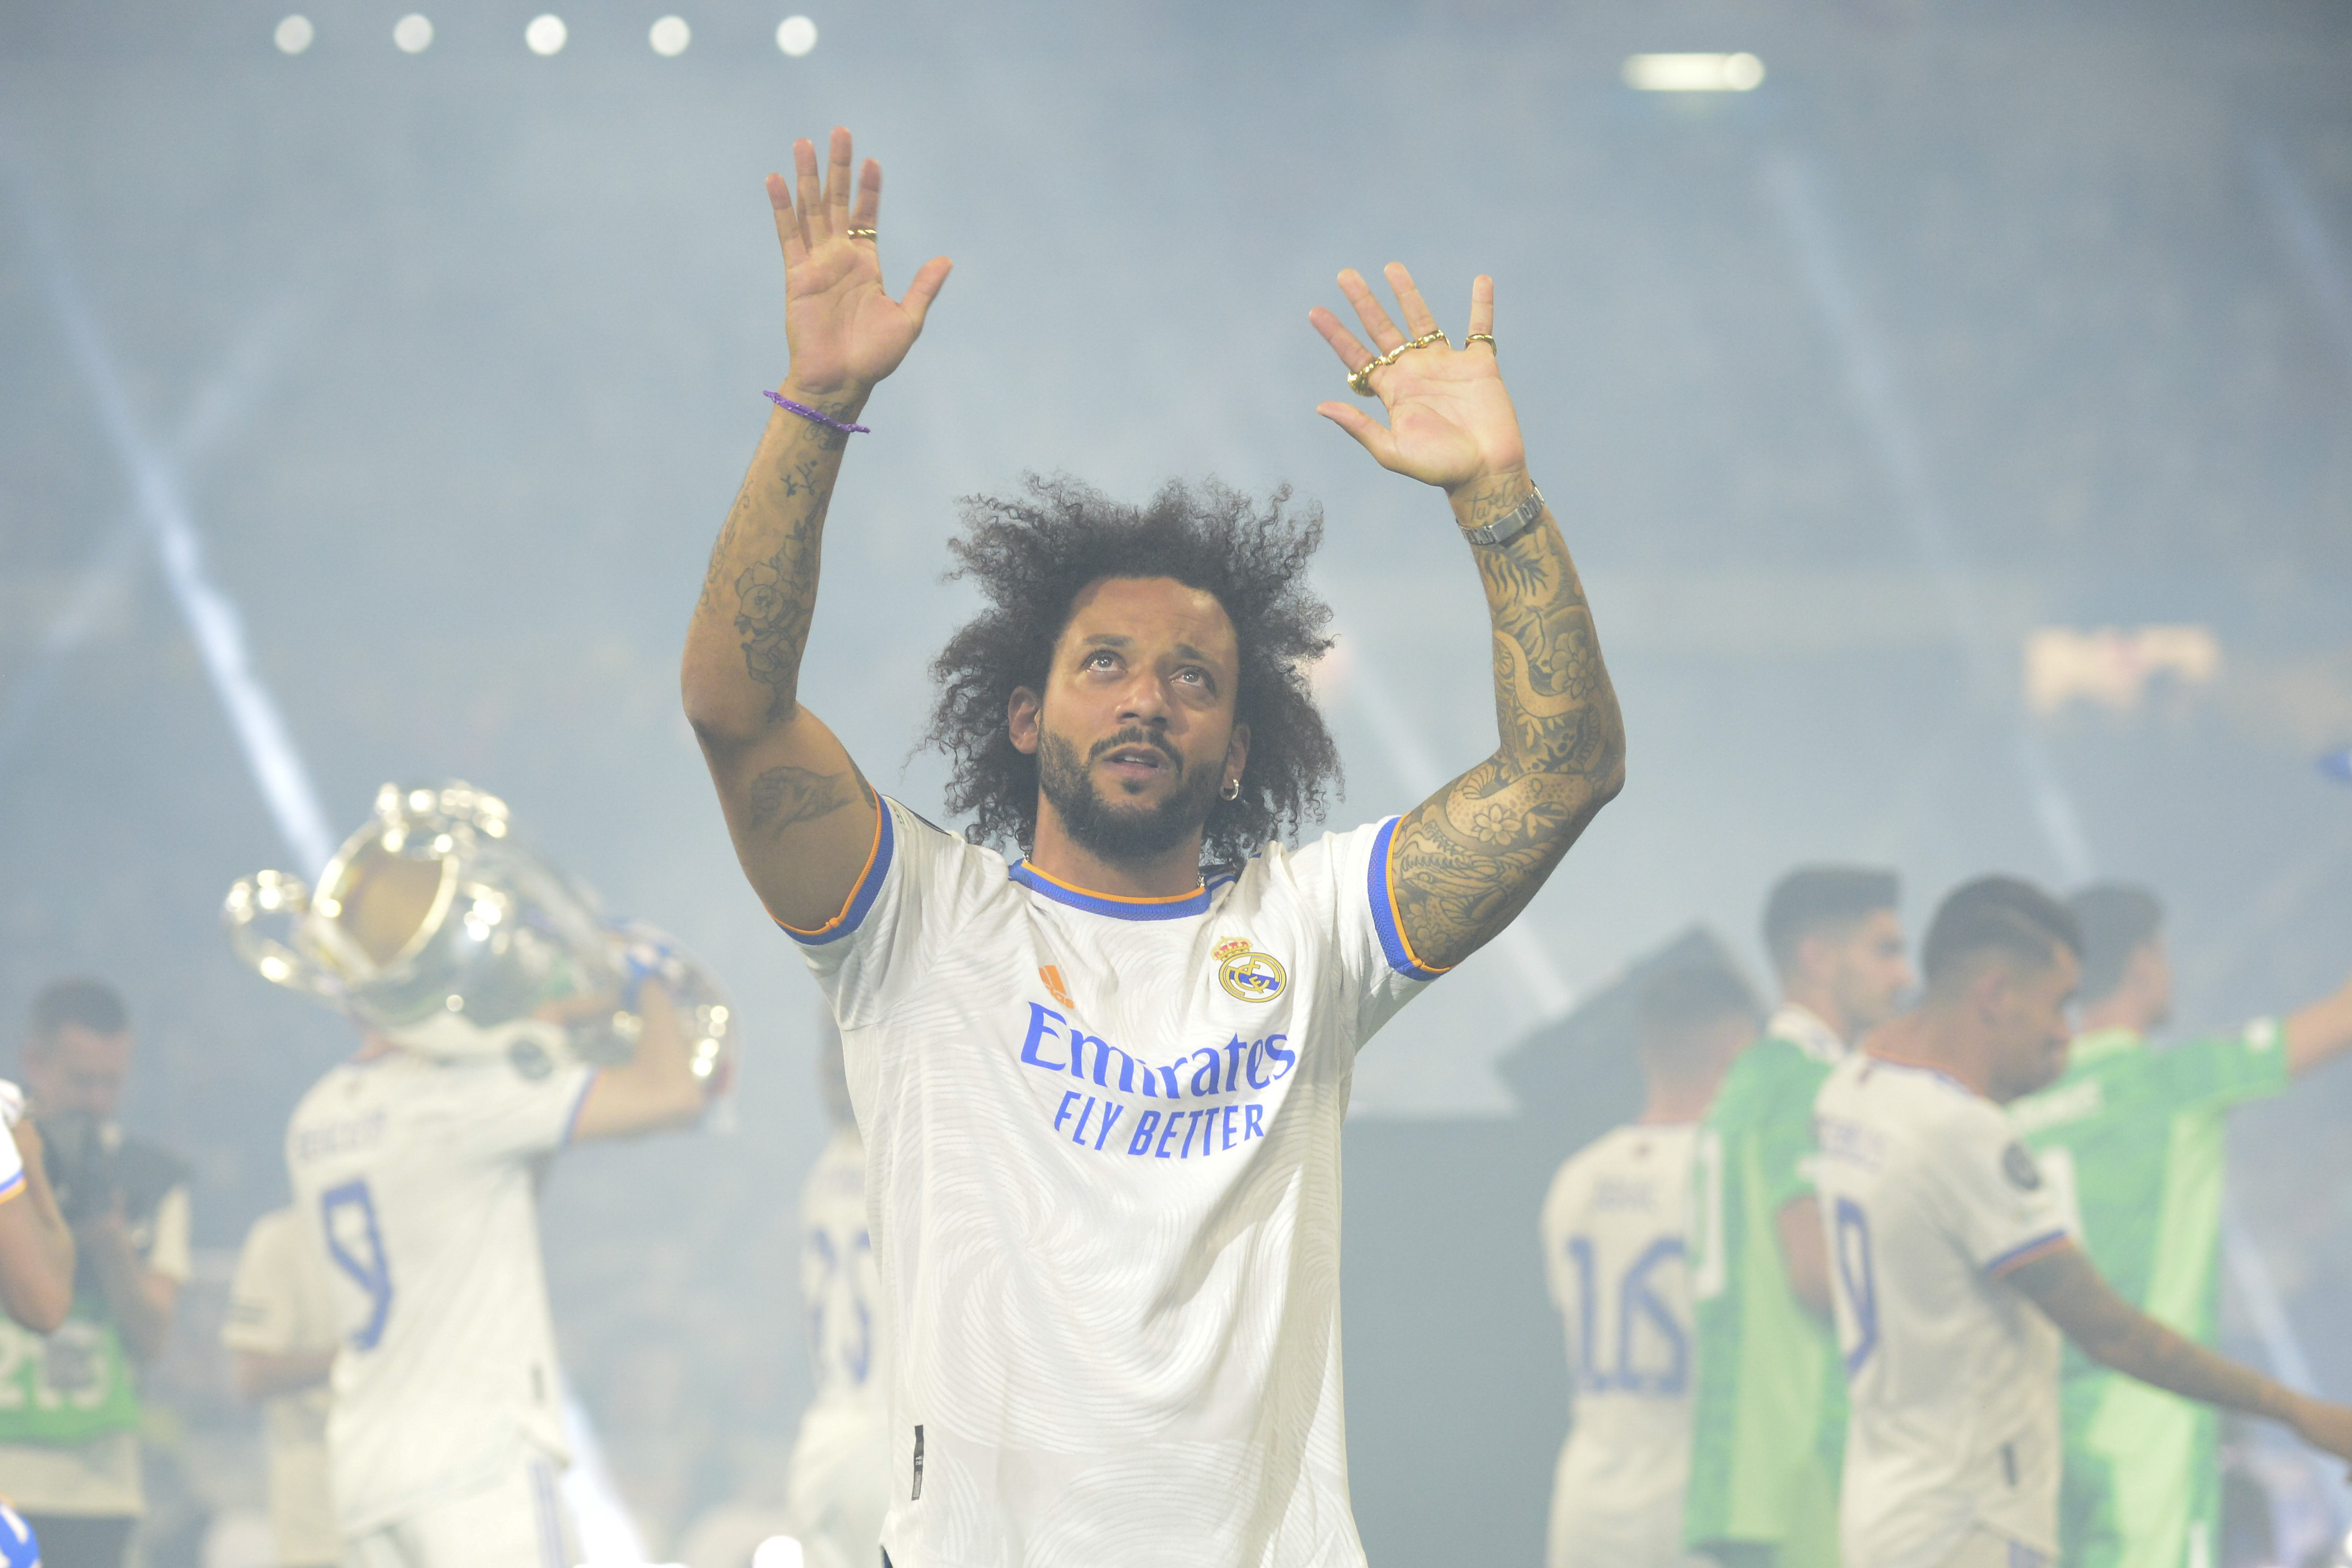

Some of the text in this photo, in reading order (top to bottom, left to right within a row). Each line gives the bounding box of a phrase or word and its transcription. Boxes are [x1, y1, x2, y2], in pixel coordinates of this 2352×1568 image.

[1021, 1001, 1296, 1099] Emirates
[1054, 1090, 1264, 1159] FLY BETTER
[323, 1179, 394, 1352] 9
